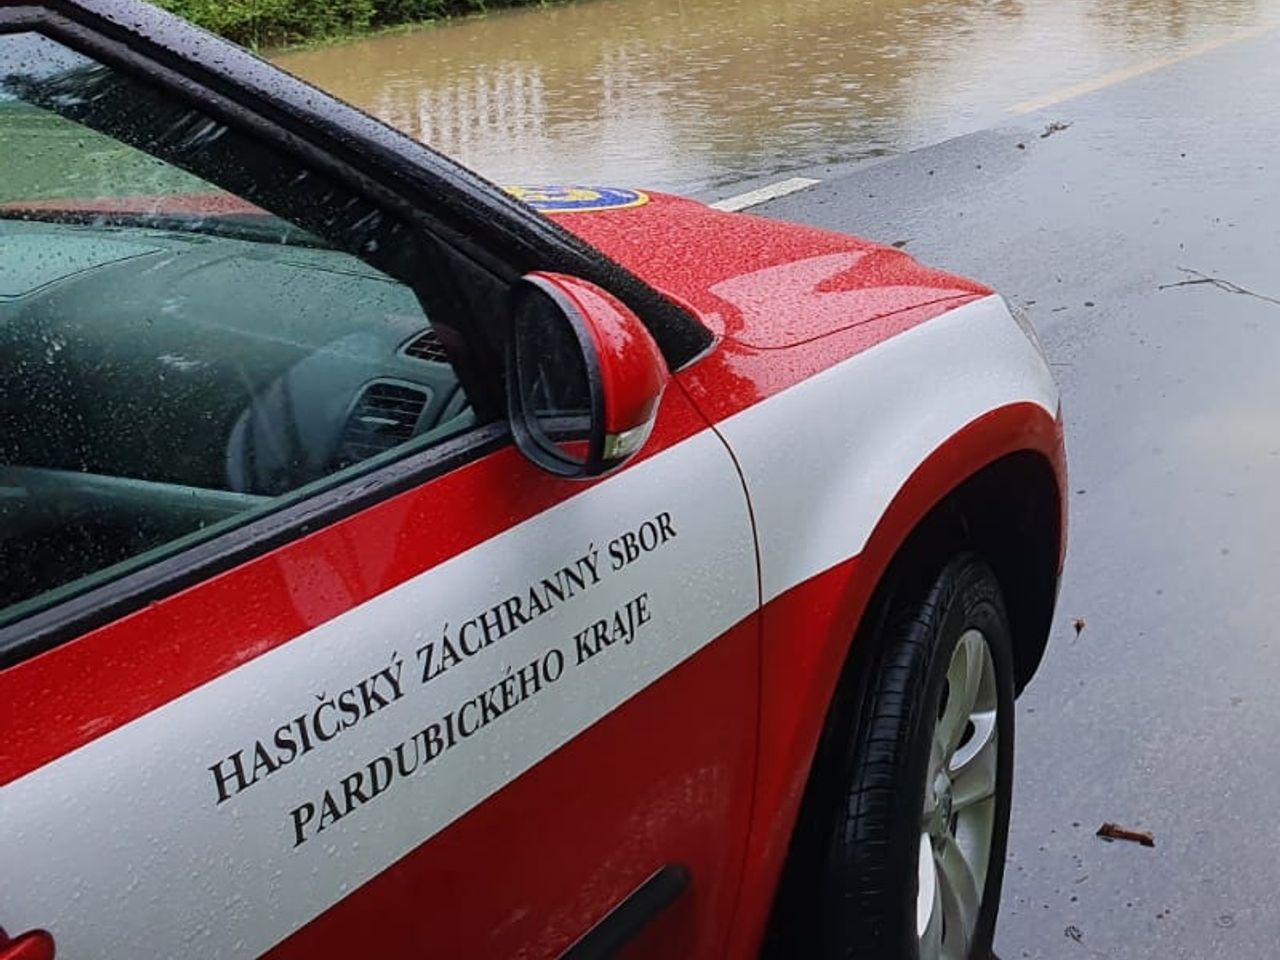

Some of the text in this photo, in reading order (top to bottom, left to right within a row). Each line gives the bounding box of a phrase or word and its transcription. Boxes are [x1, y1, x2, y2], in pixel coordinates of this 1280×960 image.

[208, 511, 678, 805] HASIČSKÝ ZÁCHRANNÝ SBOR
[290, 593, 652, 848] PARDUBICKÉHO KRAJE
